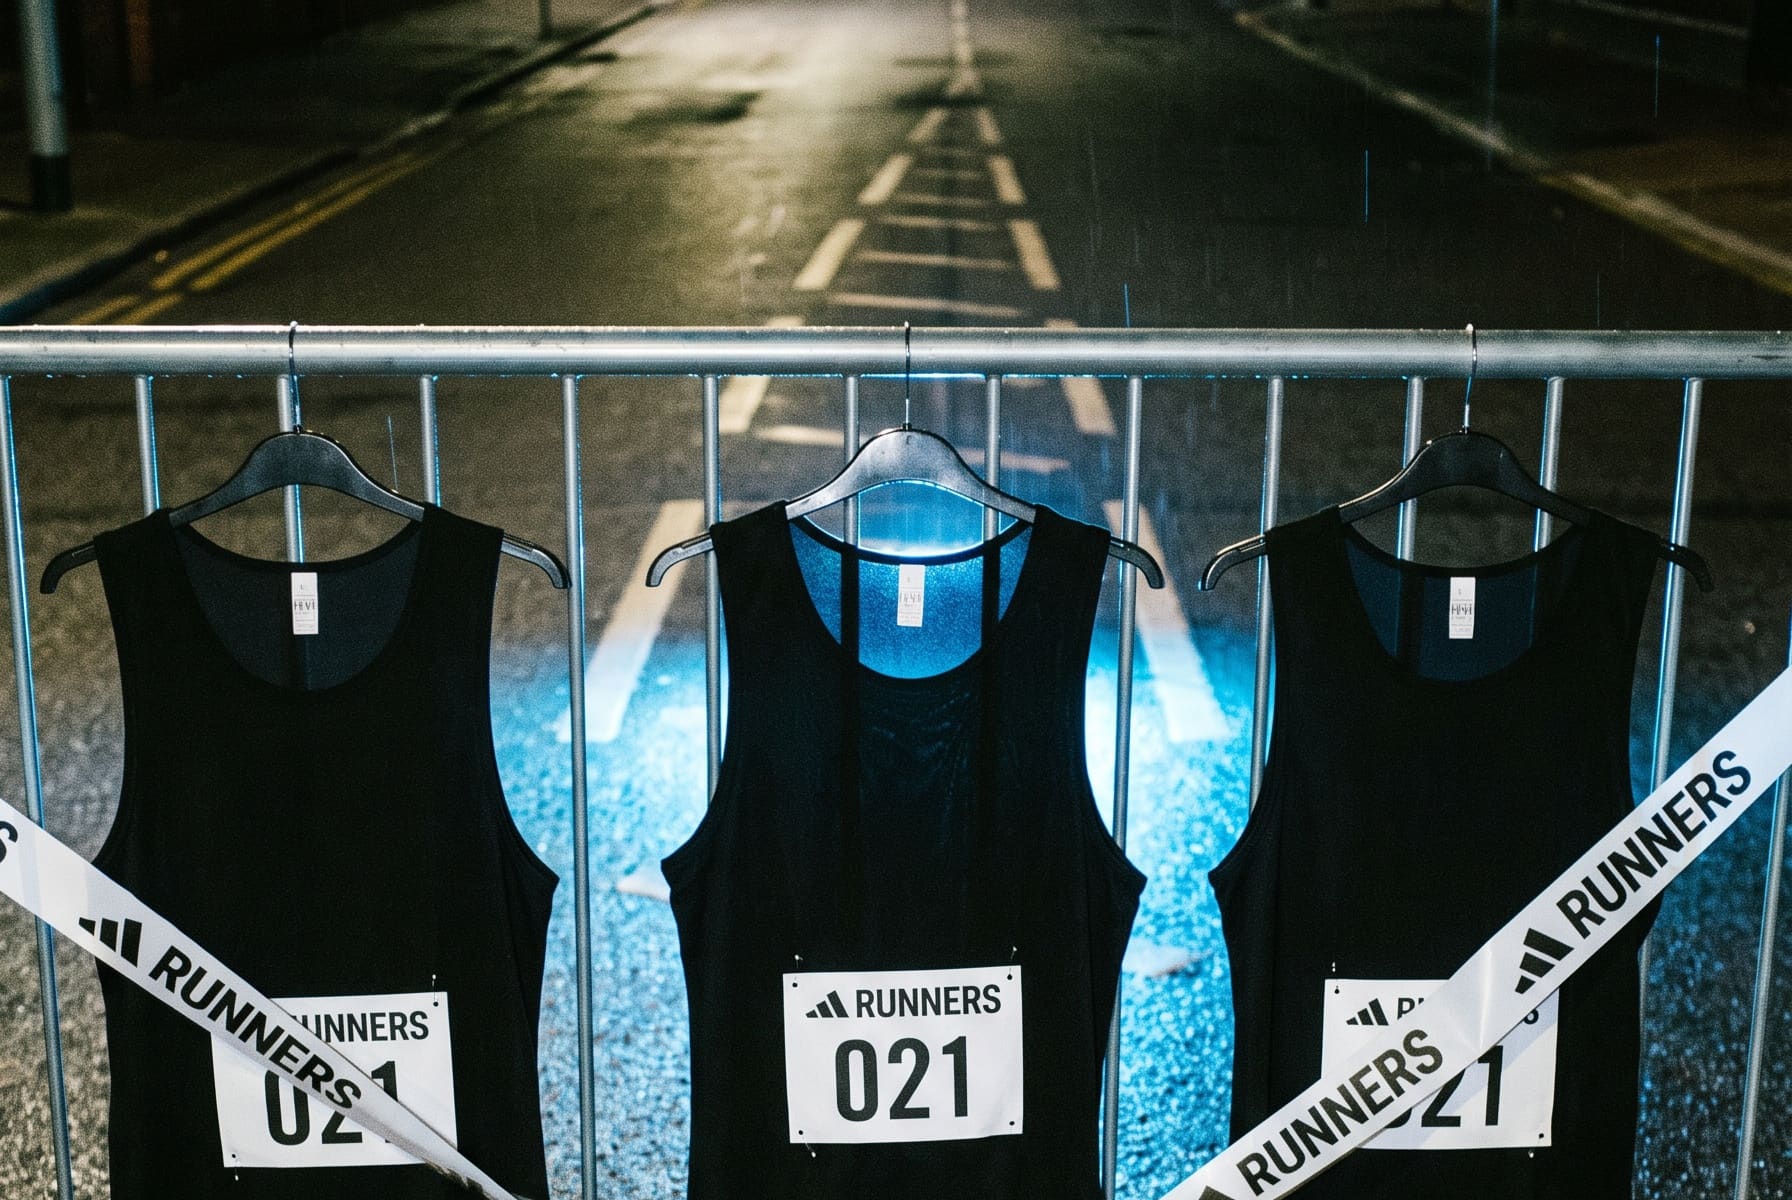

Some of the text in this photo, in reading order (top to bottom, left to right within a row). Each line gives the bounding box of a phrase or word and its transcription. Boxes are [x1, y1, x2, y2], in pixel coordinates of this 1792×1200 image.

[1555, 748, 1752, 939] RUNNERS
[148, 945, 363, 1111] RUNNERS
[856, 984, 1002, 1018] RUNNERS
[834, 1035, 969, 1123] 021
[1235, 1028, 1444, 1197] RUNNERS
[1384, 1045, 1504, 1129] 21
